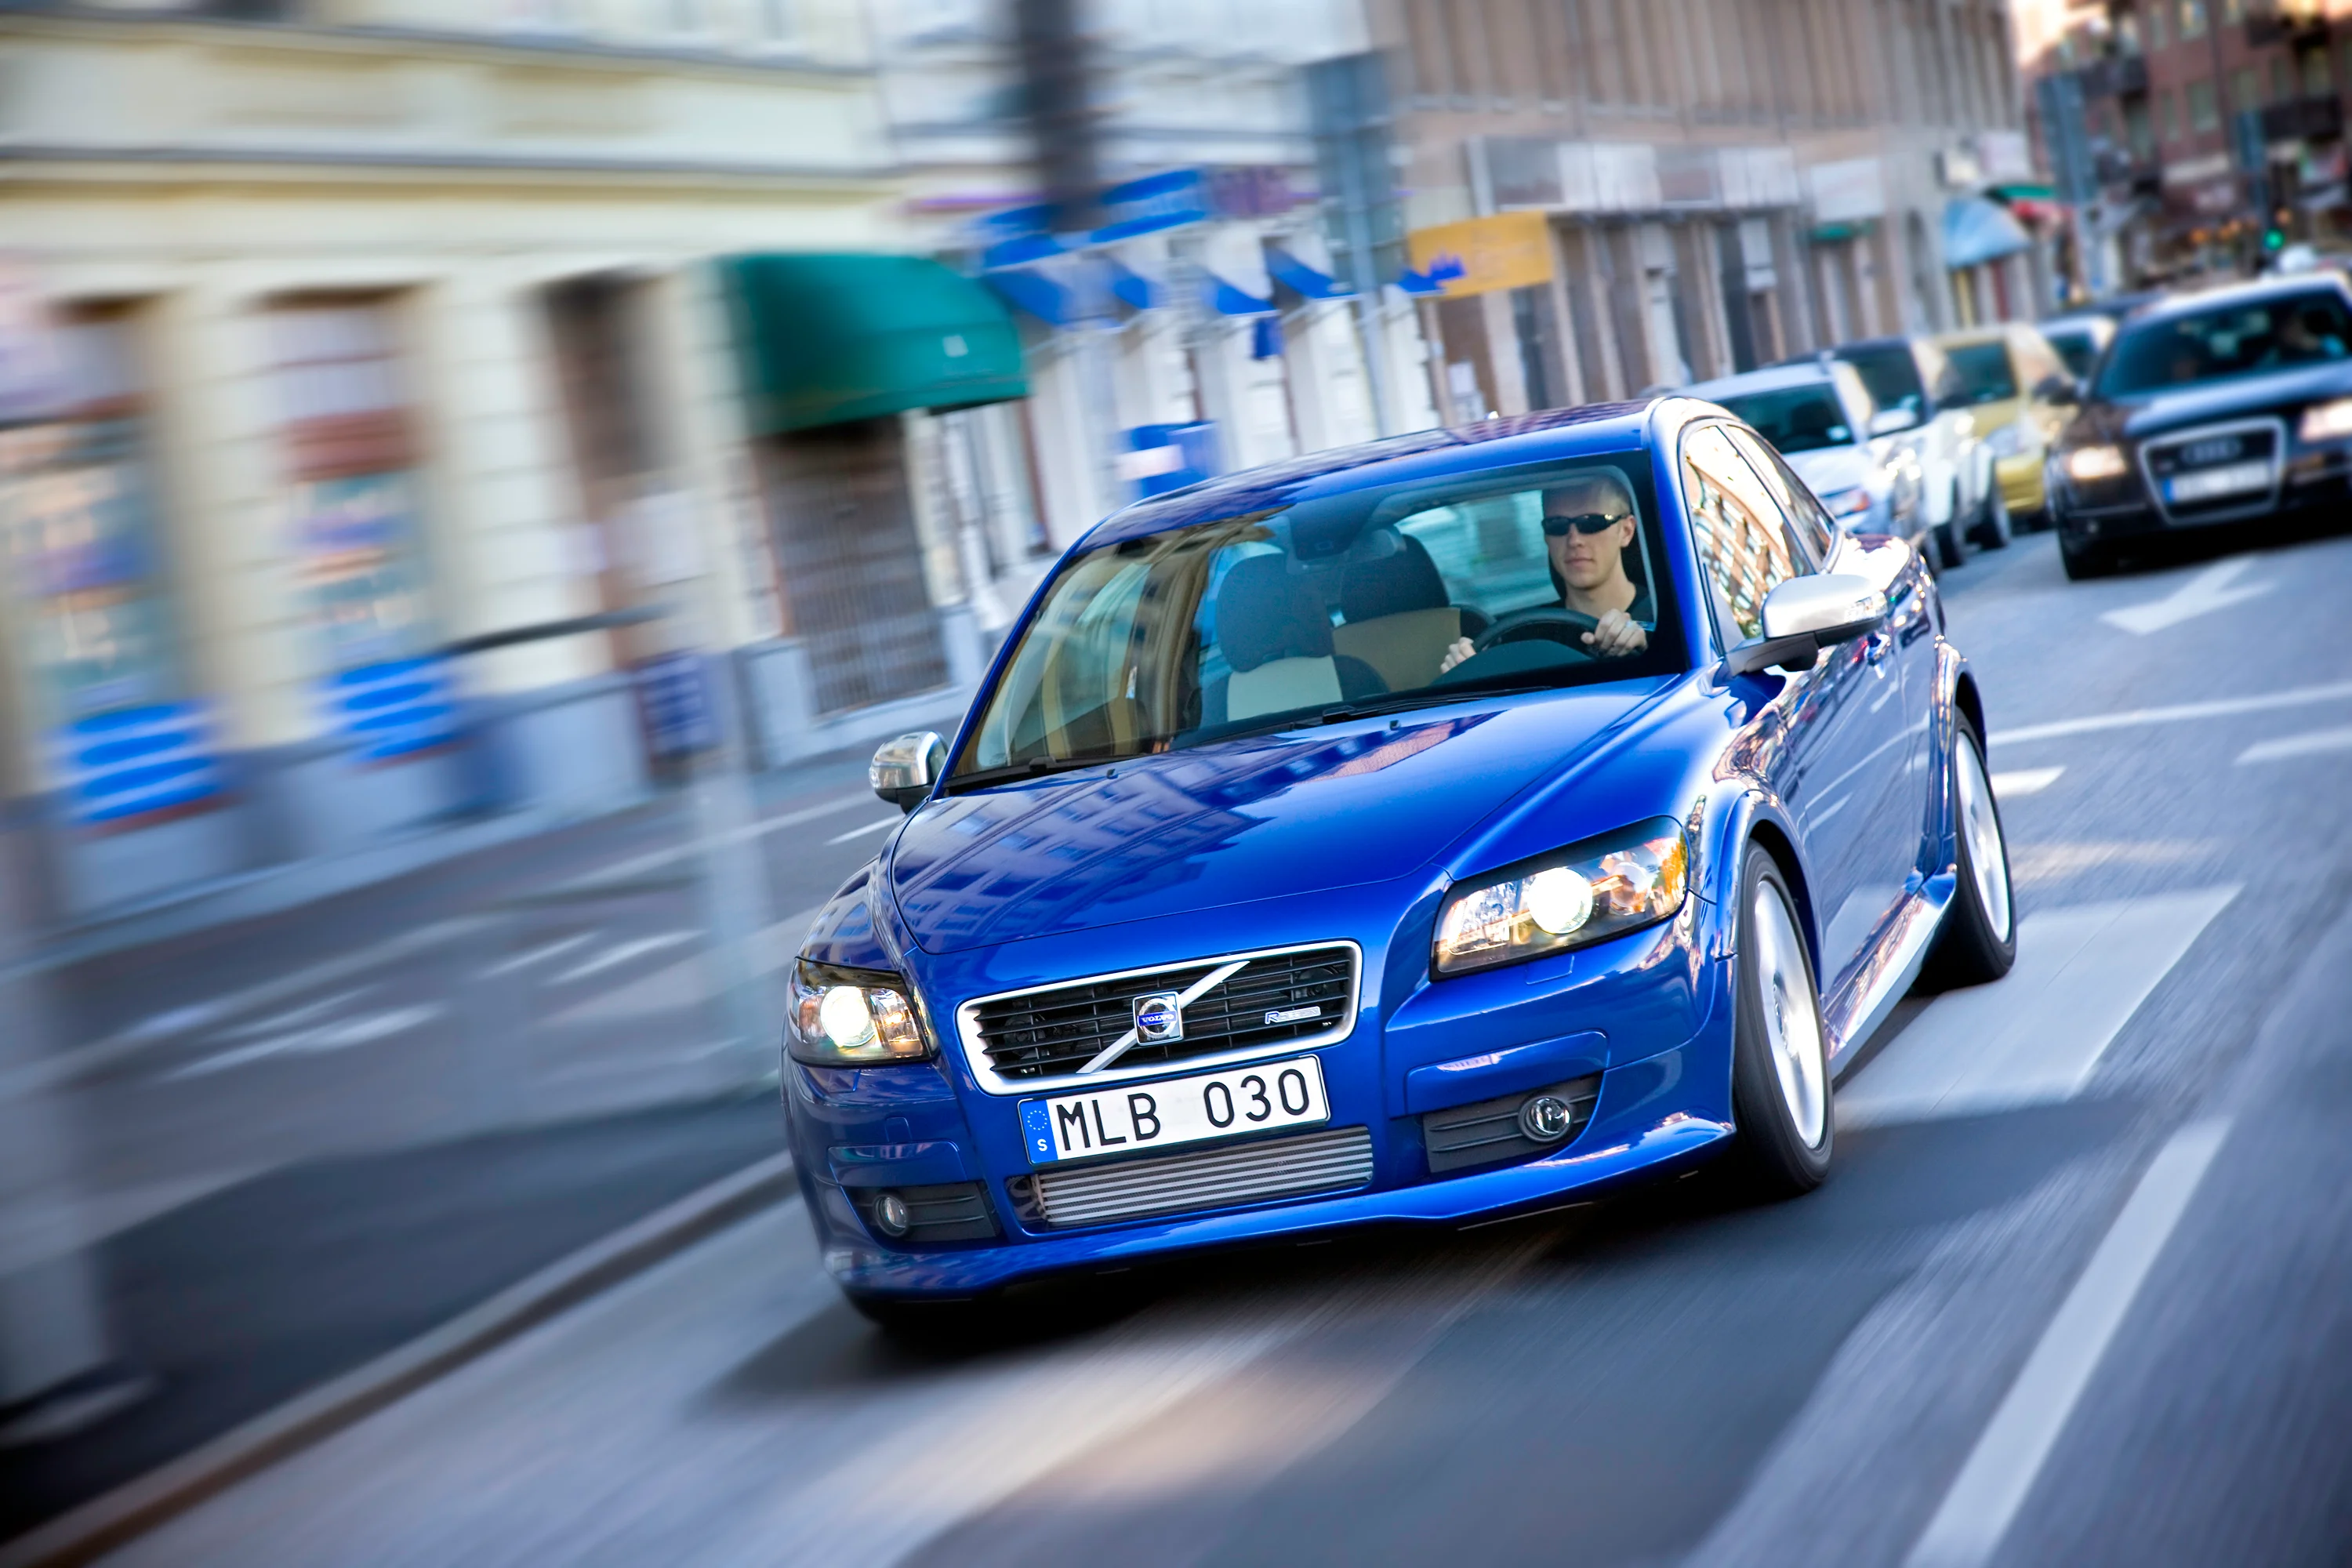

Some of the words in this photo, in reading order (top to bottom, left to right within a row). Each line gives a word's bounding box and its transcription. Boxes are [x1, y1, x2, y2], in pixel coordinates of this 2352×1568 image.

[1141, 1014, 1174, 1022] VOLVO
[1056, 1093, 1161, 1151] MLB
[1203, 1069, 1309, 1128] 030
[1038, 1138, 1048, 1152] S
